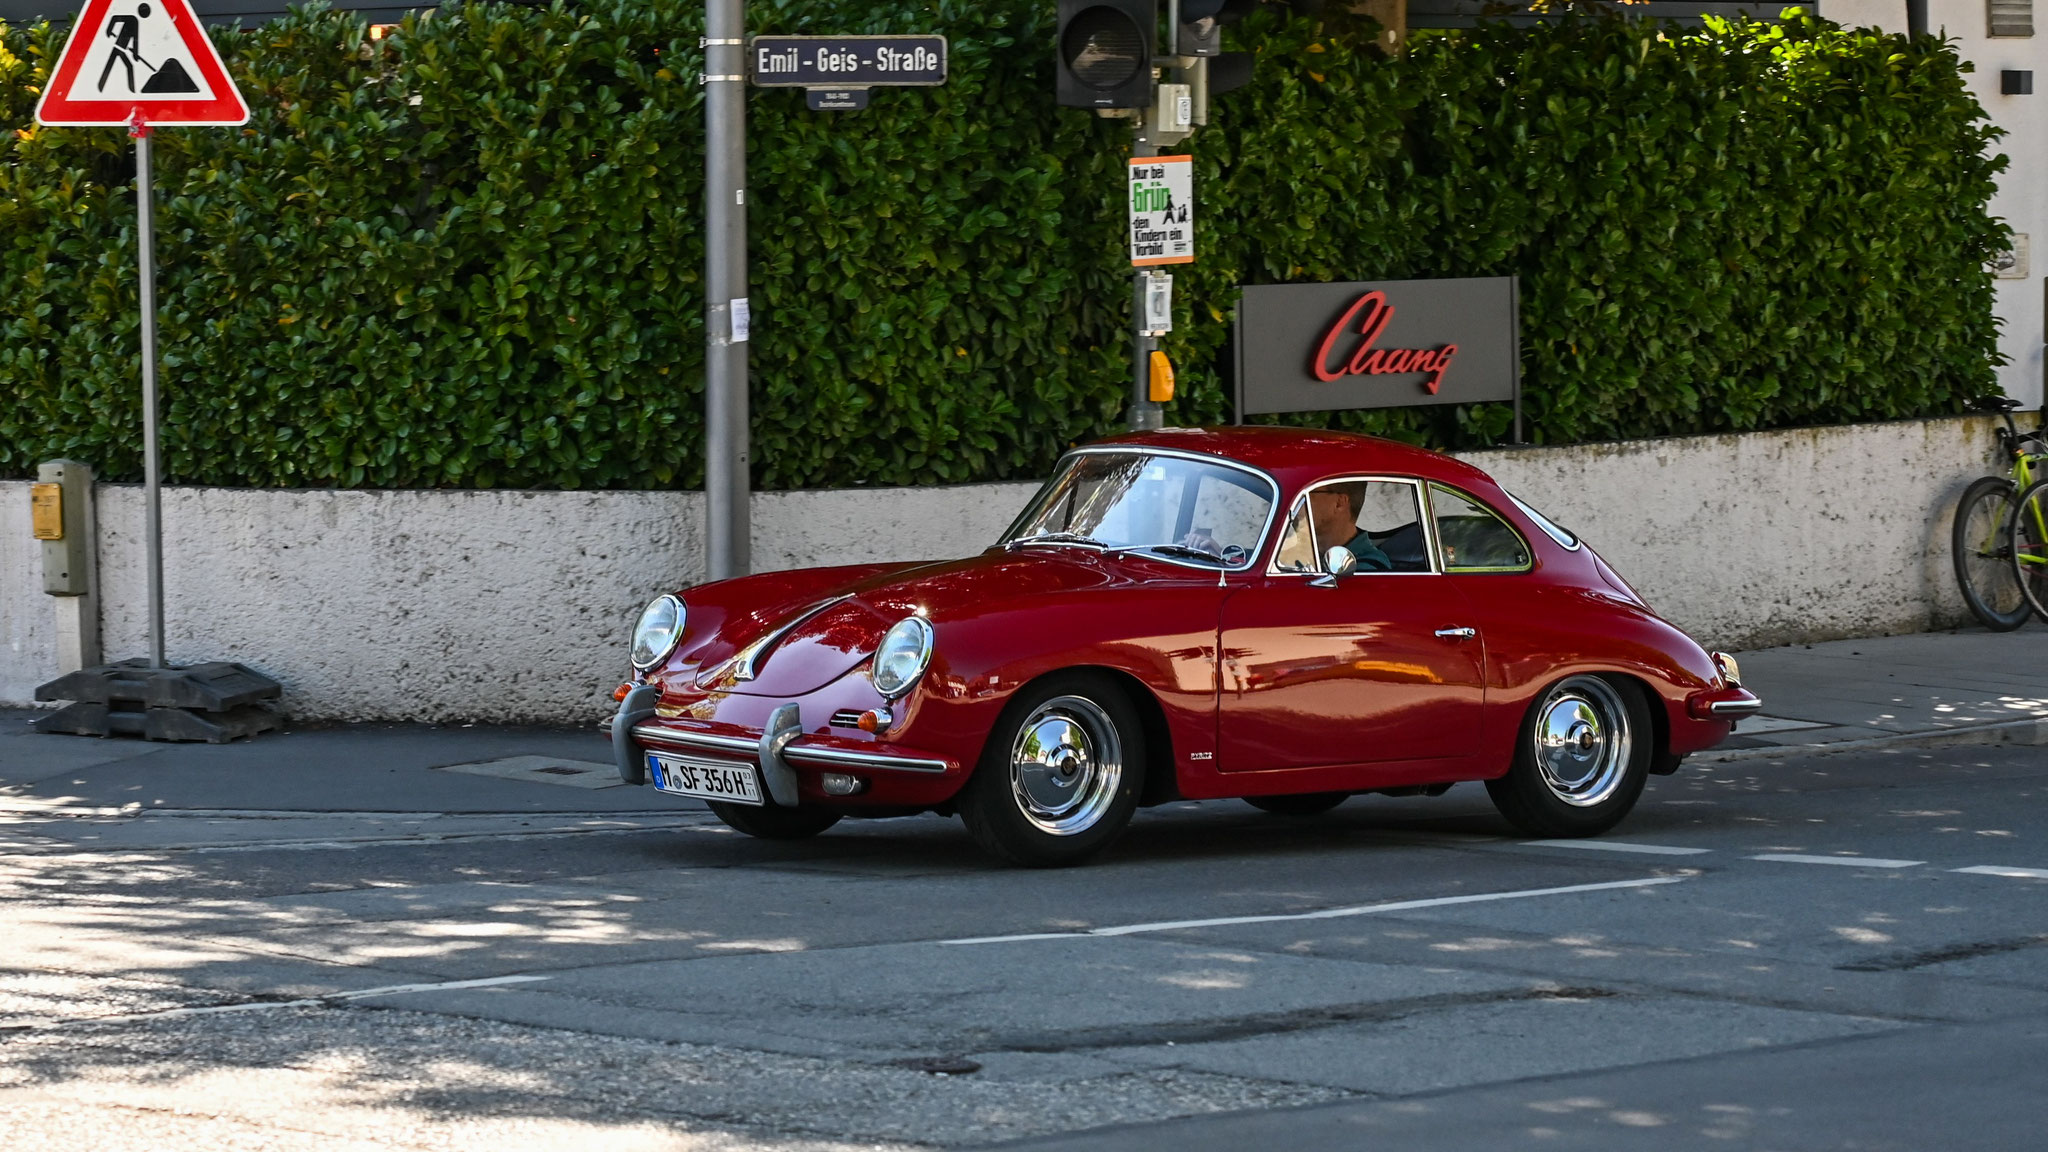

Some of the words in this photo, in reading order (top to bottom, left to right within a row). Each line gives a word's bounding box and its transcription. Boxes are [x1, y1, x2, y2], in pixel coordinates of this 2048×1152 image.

[758, 47, 798, 73] Emil
[817, 47, 858, 72] Geis
[876, 46, 938, 72] Straße
[1133, 166, 1149, 179] Nur
[1151, 165, 1164, 179] bei
[1133, 181, 1170, 212] Grün
[1133, 216, 1149, 229] den
[1135, 229, 1167, 242] Kindern
[1169, 227, 1182, 241] ein
[1133, 242, 1164, 256] Vorbild
[1315, 290, 1459, 394] Chang
[659, 762, 673, 787] M
[680, 765, 701, 790] SF
[700, 767, 747, 796] 356H
